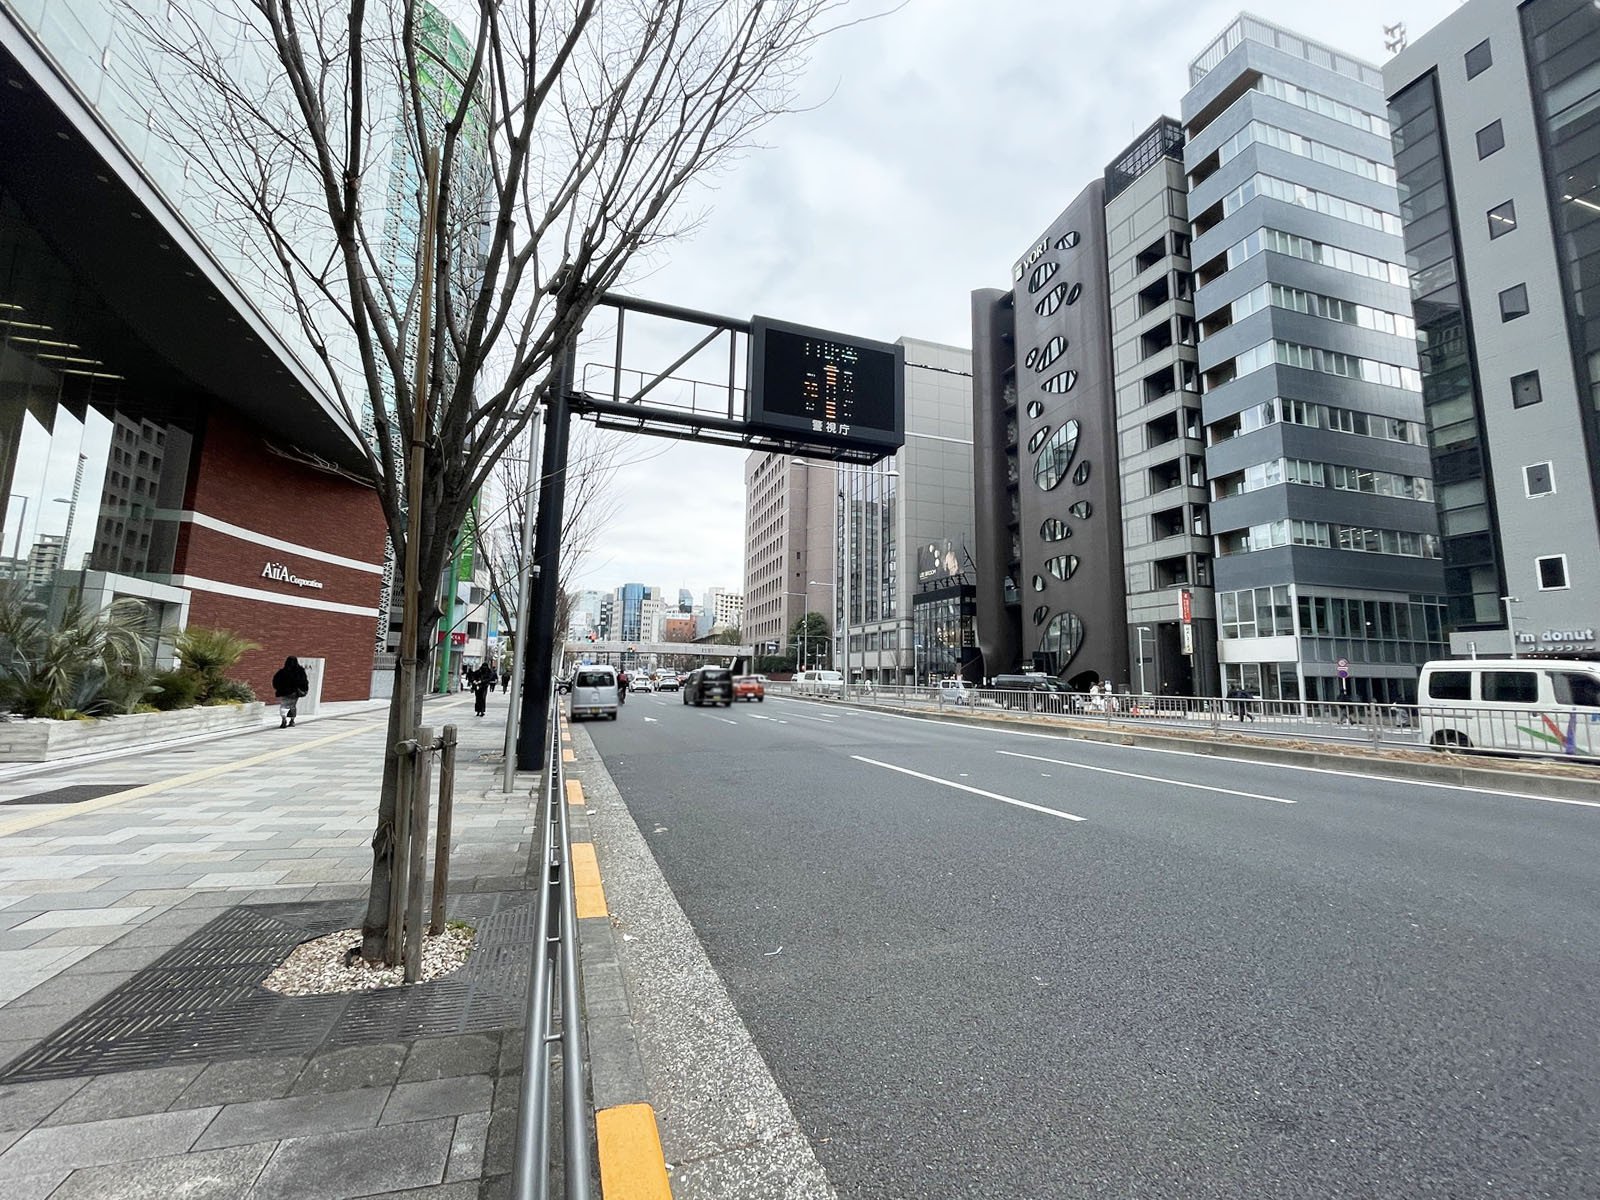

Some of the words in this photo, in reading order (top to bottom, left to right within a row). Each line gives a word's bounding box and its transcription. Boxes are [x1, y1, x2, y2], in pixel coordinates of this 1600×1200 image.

[1023, 237, 1049, 269] VORT
[812, 419, 850, 435] 警視庁
[290, 575, 323, 588] Corporation
[1541, 629, 1594, 641] donut
